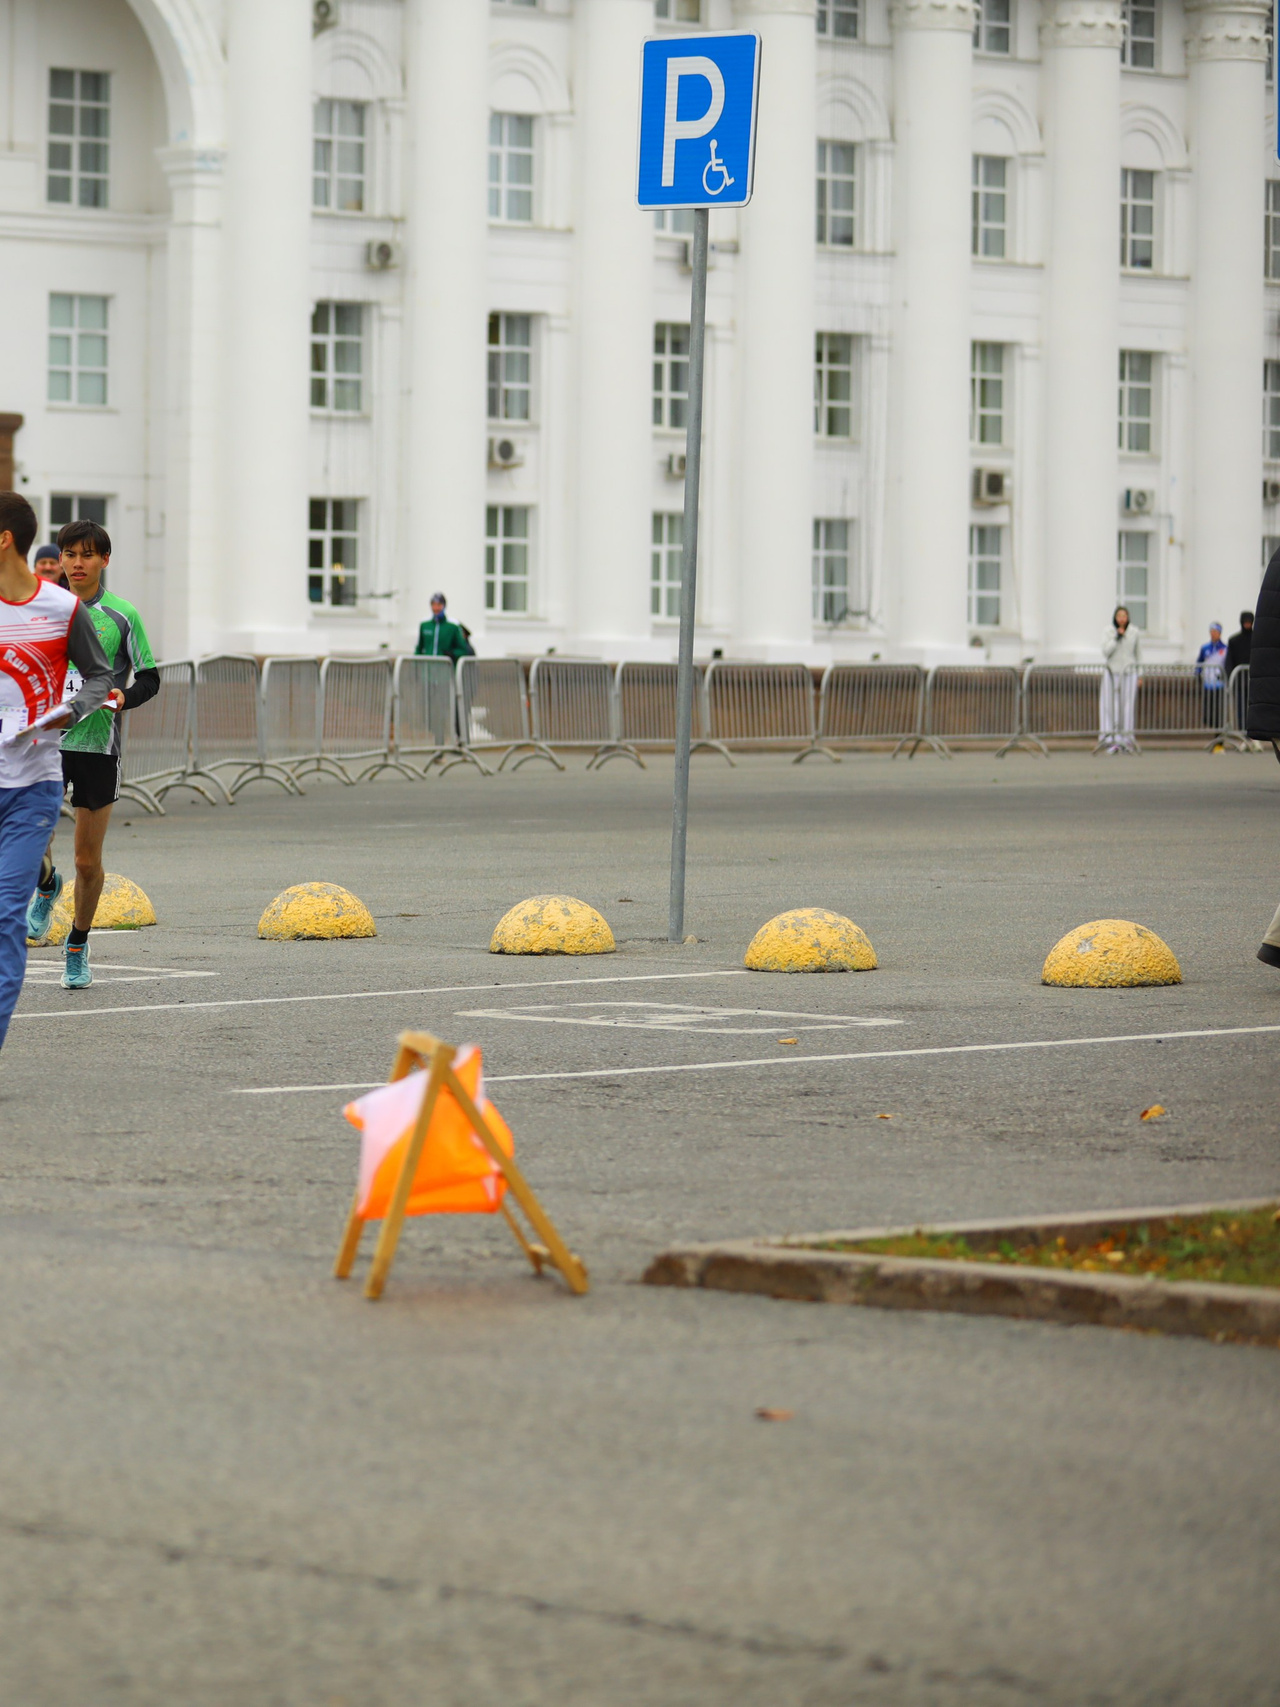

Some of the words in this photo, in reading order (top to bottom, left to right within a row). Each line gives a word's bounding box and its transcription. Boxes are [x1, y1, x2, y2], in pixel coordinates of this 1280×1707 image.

[661, 55, 726, 187] P
[3, 648, 30, 674] Run
[27, 674, 45, 696] and
